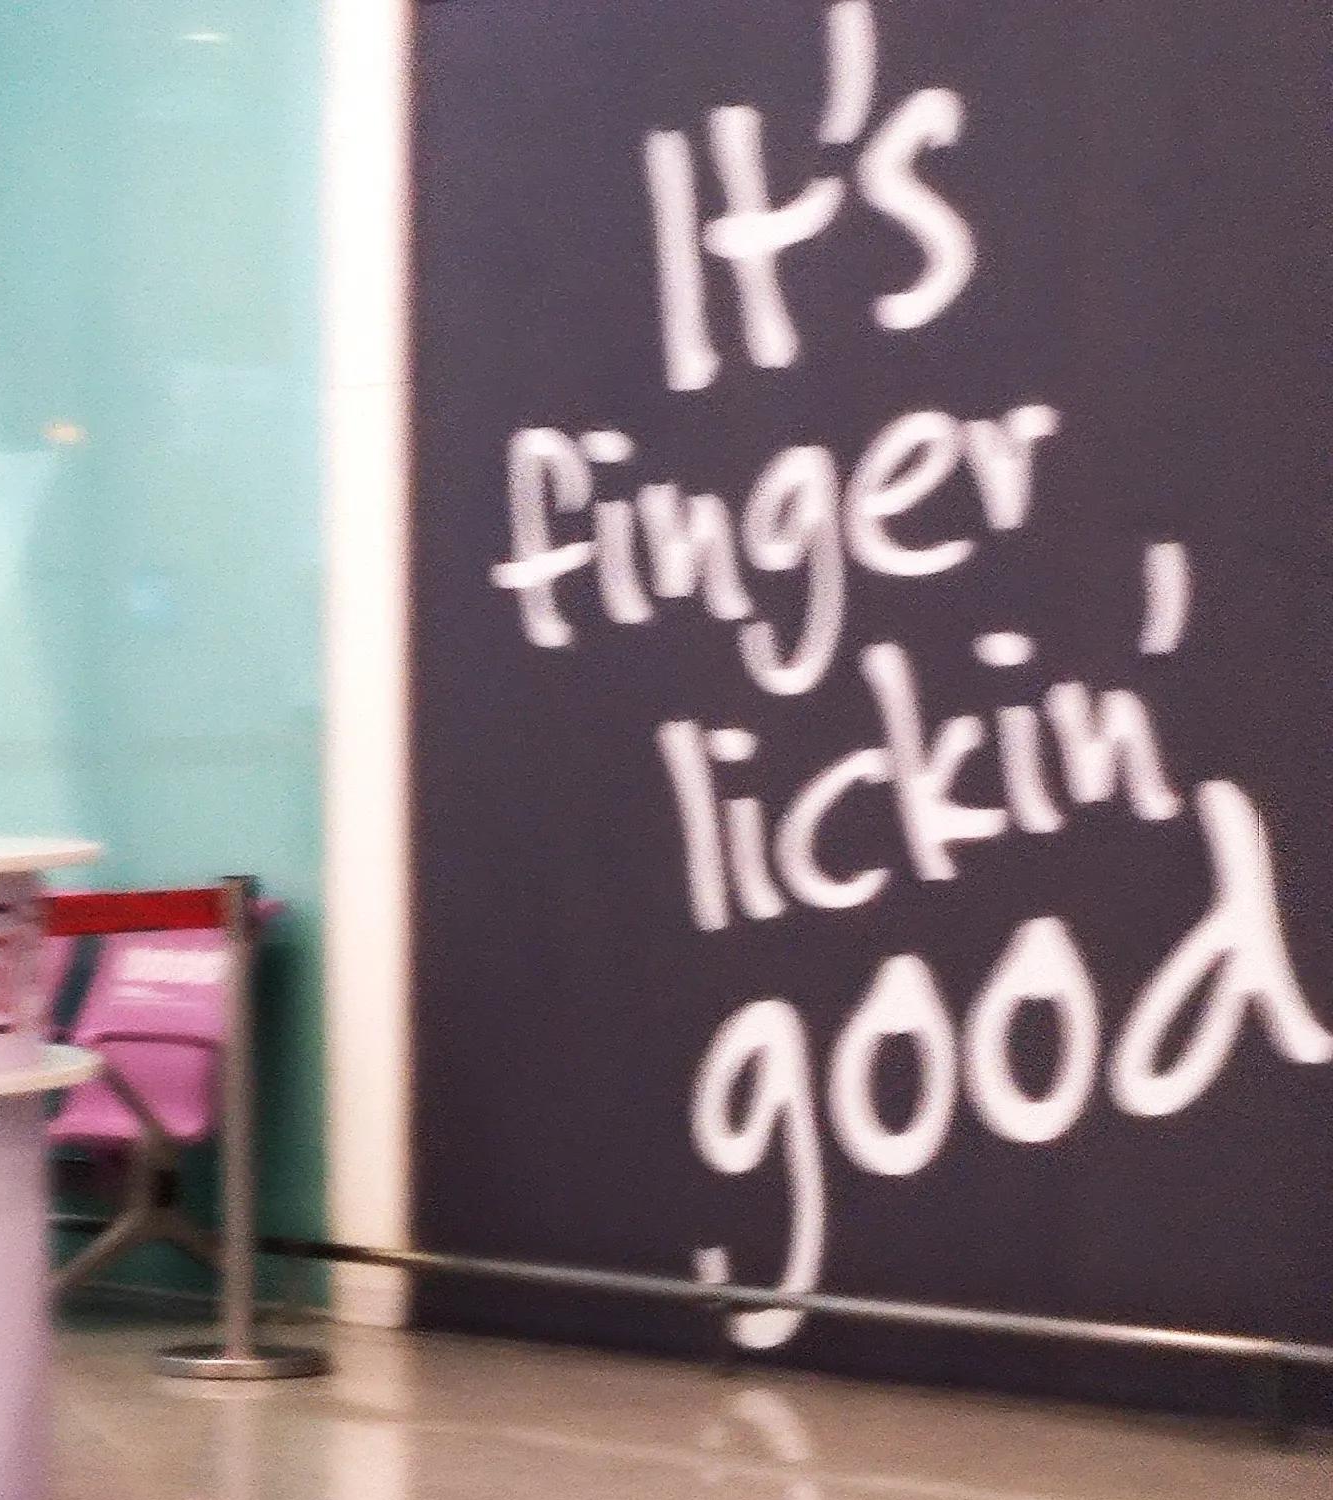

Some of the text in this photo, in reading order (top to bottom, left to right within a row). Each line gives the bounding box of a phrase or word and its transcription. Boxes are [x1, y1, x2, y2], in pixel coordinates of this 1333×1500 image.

[645, 0, 976, 391] It's
[490, 403, 1062, 697] finger
[655, 540, 1195, 932] lickin'
[689, 780, 1333, 1350] good
